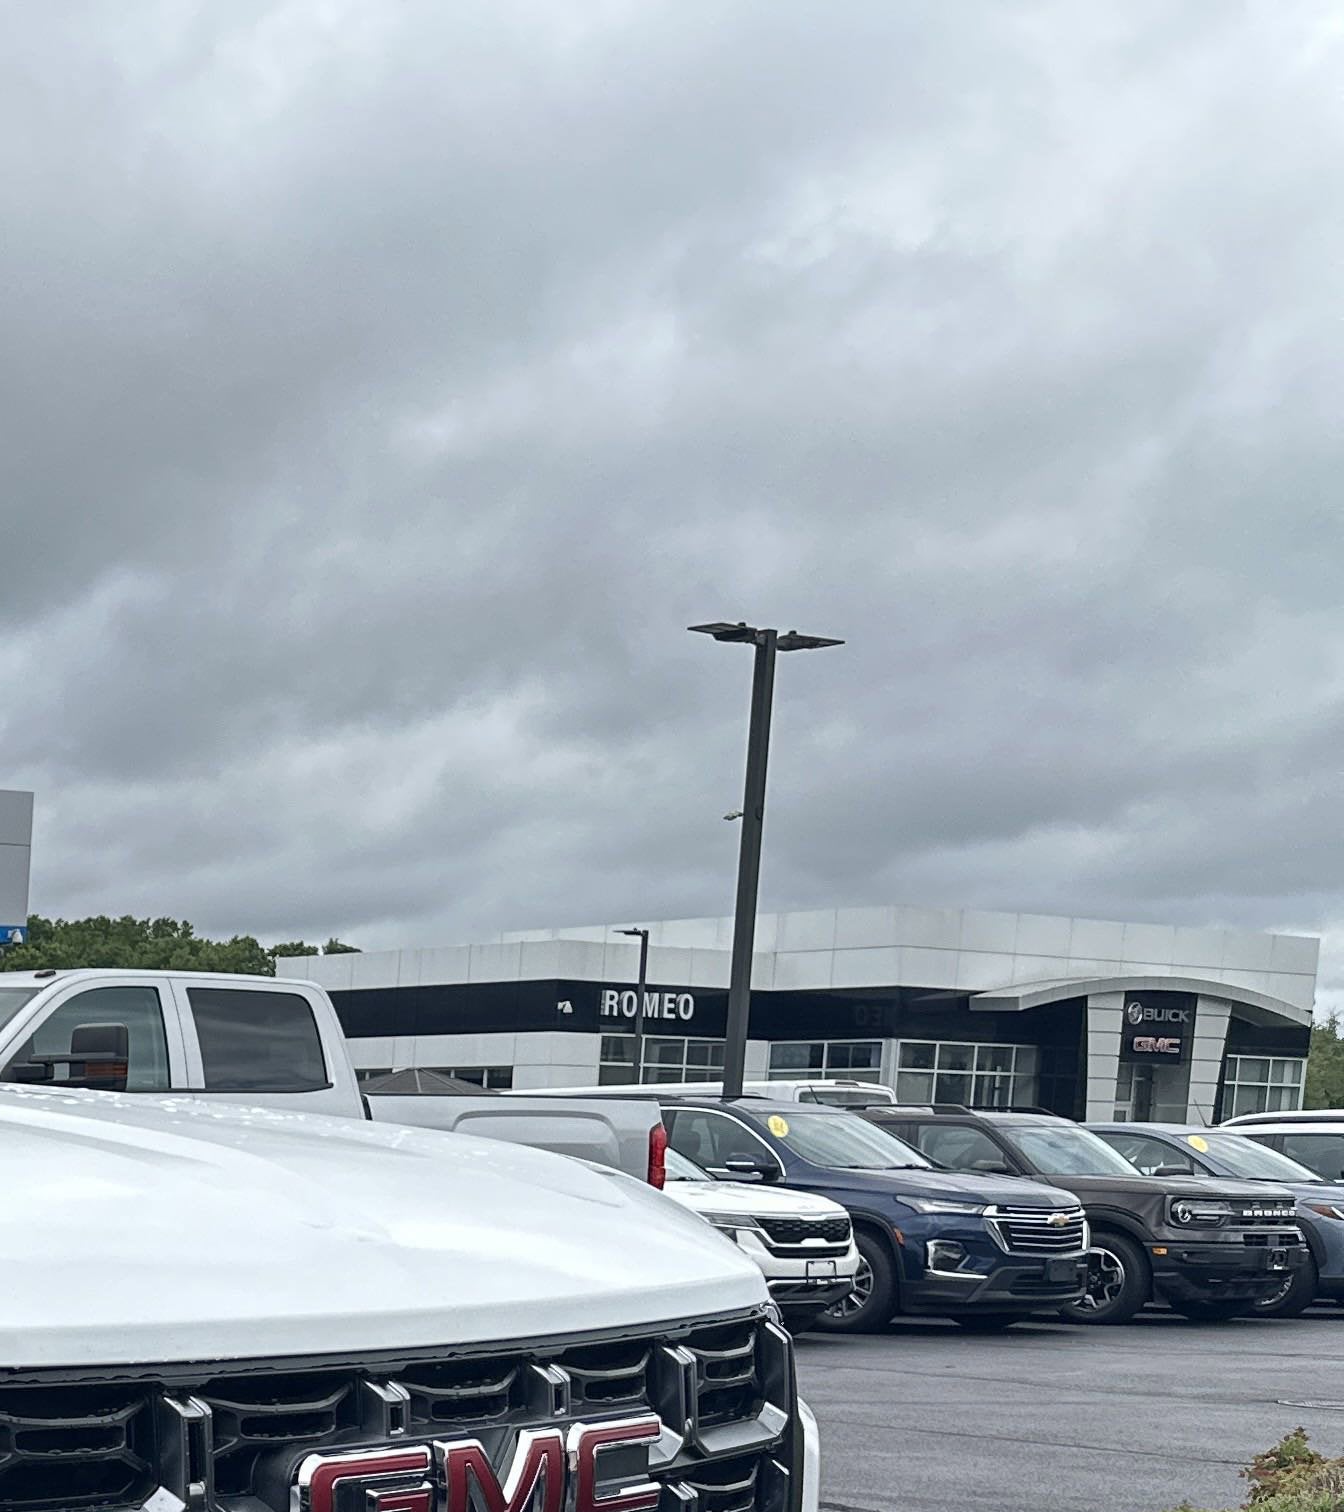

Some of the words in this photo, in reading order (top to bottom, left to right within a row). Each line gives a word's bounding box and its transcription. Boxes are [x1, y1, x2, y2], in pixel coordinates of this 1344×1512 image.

[600, 989, 695, 1020] ROMEO
[1143, 1007, 1190, 1022] BUICK
[1133, 1036, 1181, 1053] GMC
